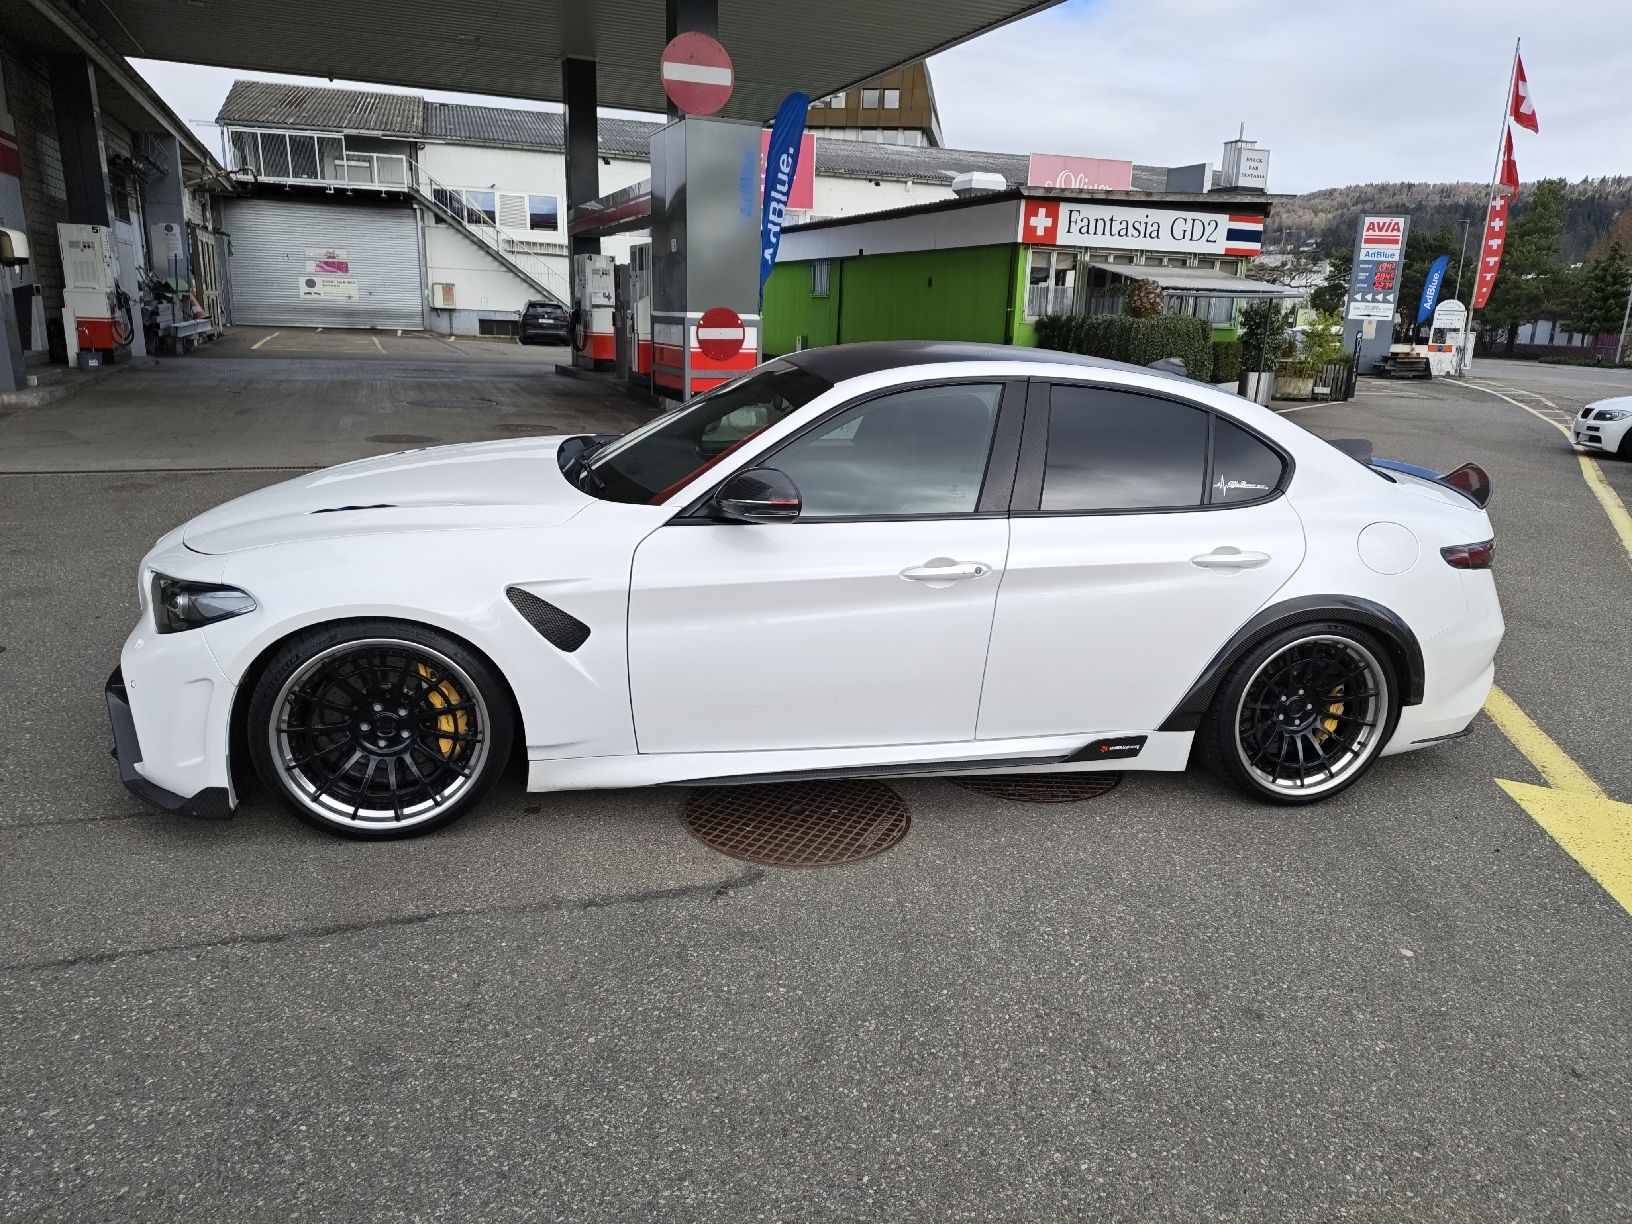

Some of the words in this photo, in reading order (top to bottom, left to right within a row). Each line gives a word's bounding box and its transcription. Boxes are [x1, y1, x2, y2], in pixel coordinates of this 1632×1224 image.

[91, 225, 99, 234] 5
[1065, 209, 1161, 240] Fantasia
[1170, 217, 1219, 243] GD2
[1366, 219, 1401, 233] AVIA
[609, 255, 615, 263] 3
[1365, 251, 1395, 260] AdBlue
